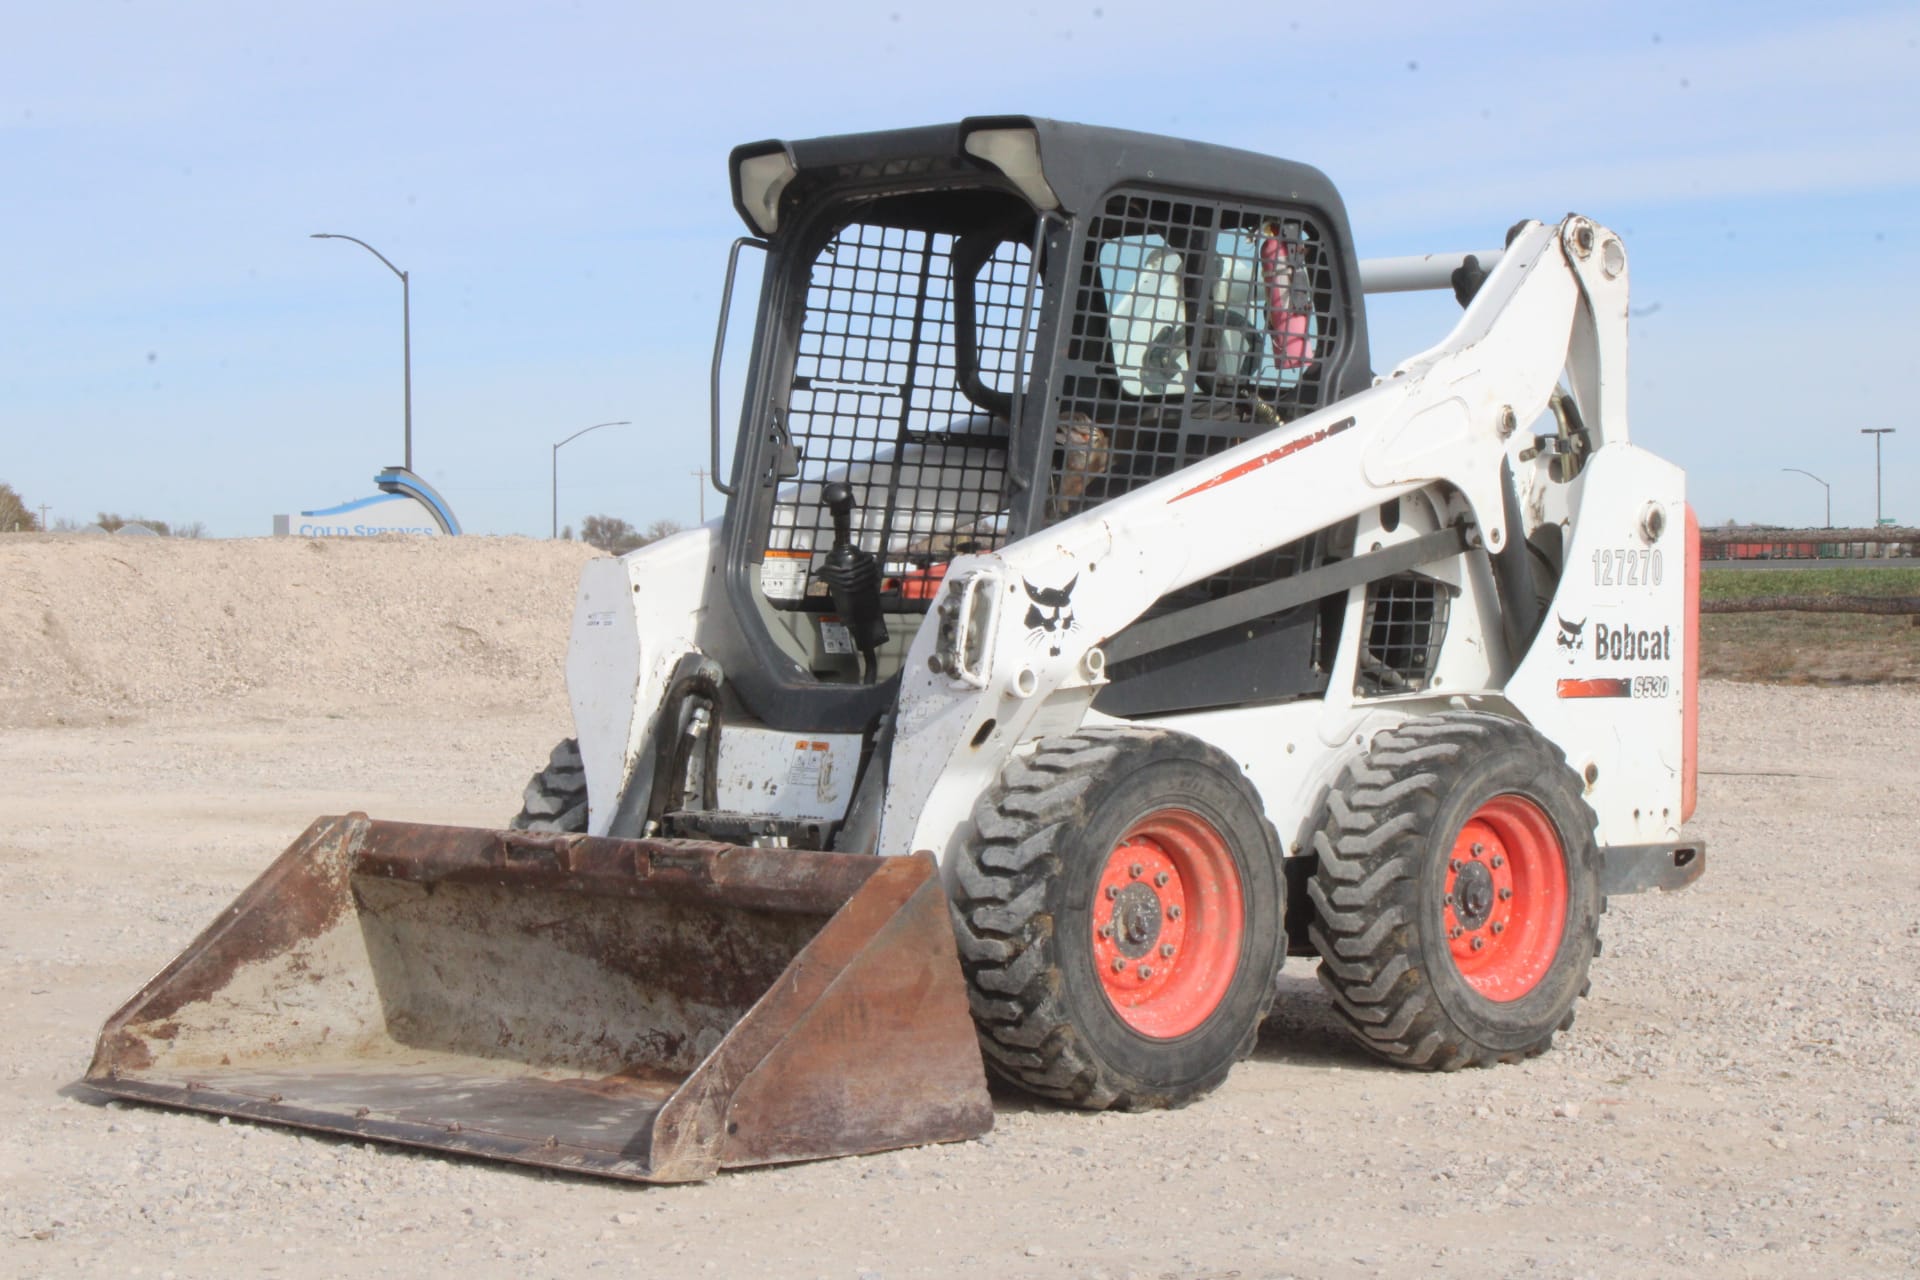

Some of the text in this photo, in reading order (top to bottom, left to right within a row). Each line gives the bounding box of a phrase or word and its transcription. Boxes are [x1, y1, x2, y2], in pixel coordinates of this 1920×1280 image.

[300, 524, 349, 536] COLD
[1592, 549, 1663, 586] 127270
[1595, 623, 1670, 661] Bobcat
[1634, 676, 1669, 698] S530
